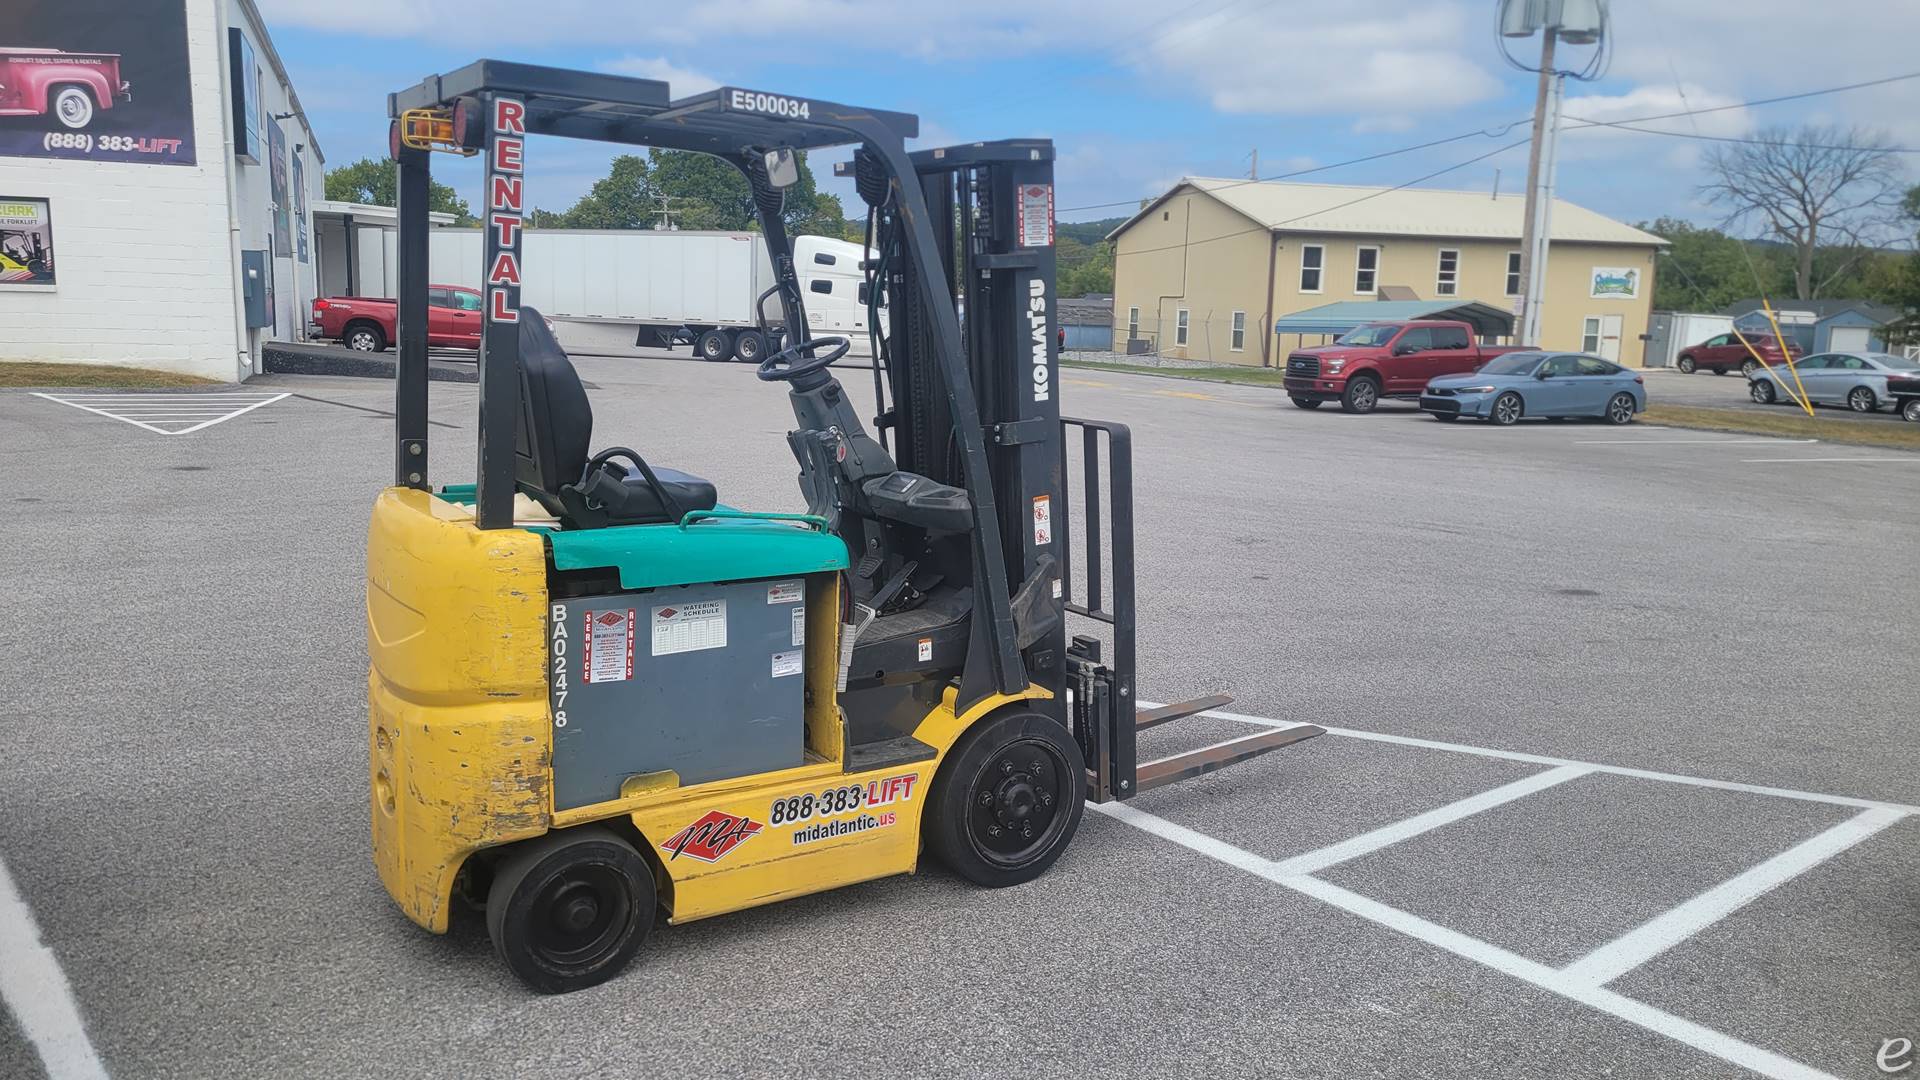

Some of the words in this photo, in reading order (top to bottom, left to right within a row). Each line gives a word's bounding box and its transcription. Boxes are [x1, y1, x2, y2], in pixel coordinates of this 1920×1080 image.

[731, 89, 810, 120] E500034
[44, 132, 94, 153] (888)
[98, 135, 182, 154] 383-LIFT
[489, 97, 526, 324] RENTAL
[1026, 279, 1049, 402] KOMATSU
[683, 602, 720, 612] WATERING
[683, 608, 720, 617] SCHEDULE
[552, 604, 568, 728] BA02478
[584, 613, 592, 680] SERVICE
[627, 611, 635, 677] RENTALS
[793, 812, 897, 845] midatlantic.us
